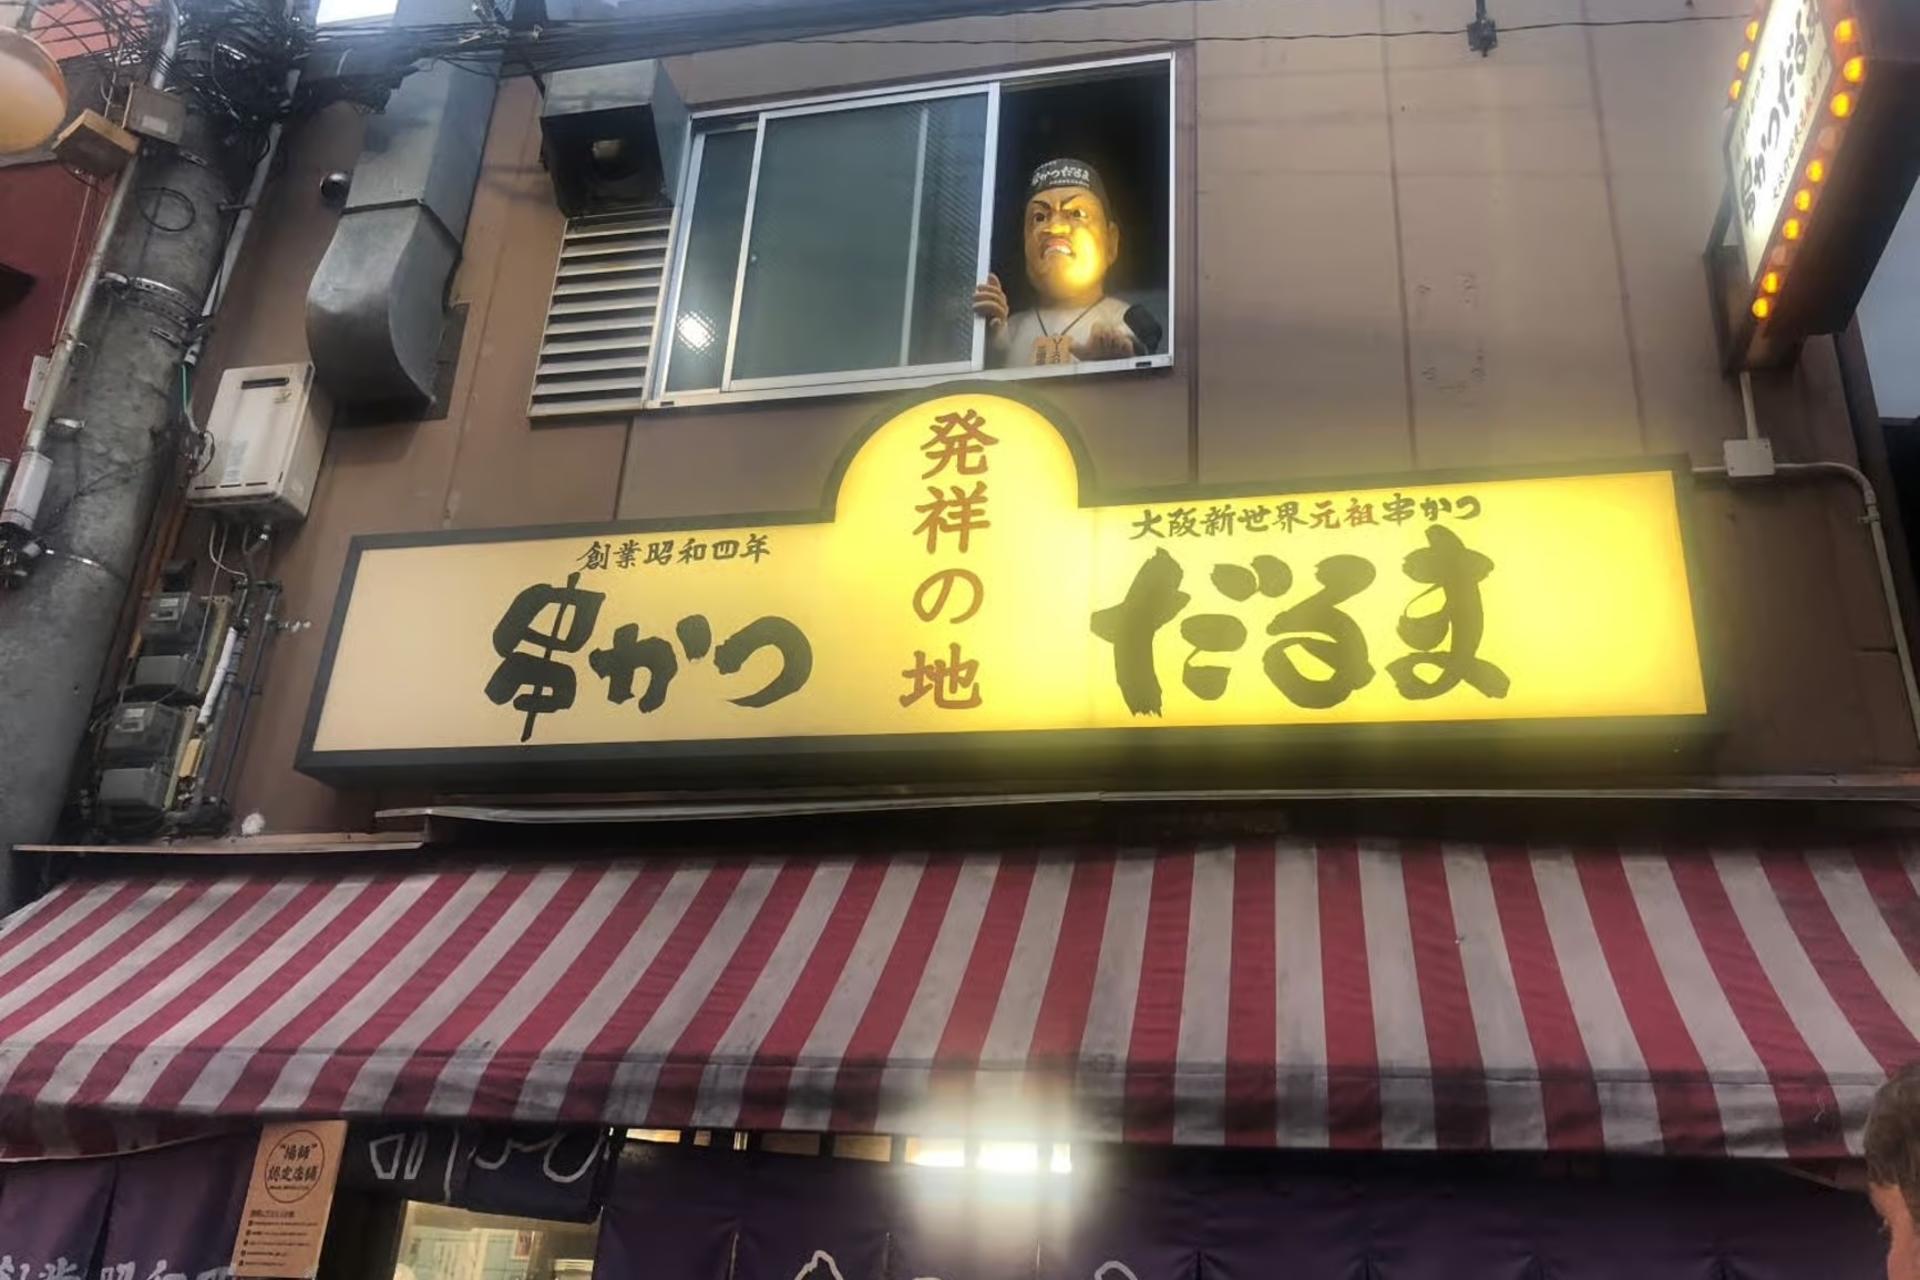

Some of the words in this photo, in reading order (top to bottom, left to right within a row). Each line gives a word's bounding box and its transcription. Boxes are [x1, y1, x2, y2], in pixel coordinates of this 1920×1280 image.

[576, 533, 771, 571] 創業昭和四年
[899, 408, 1000, 710] 発祥の地
[1129, 492, 1482, 542] 大阪新世界元祖串かつ
[484, 572, 813, 742] 串かつ
[1090, 524, 1511, 718] だるま
